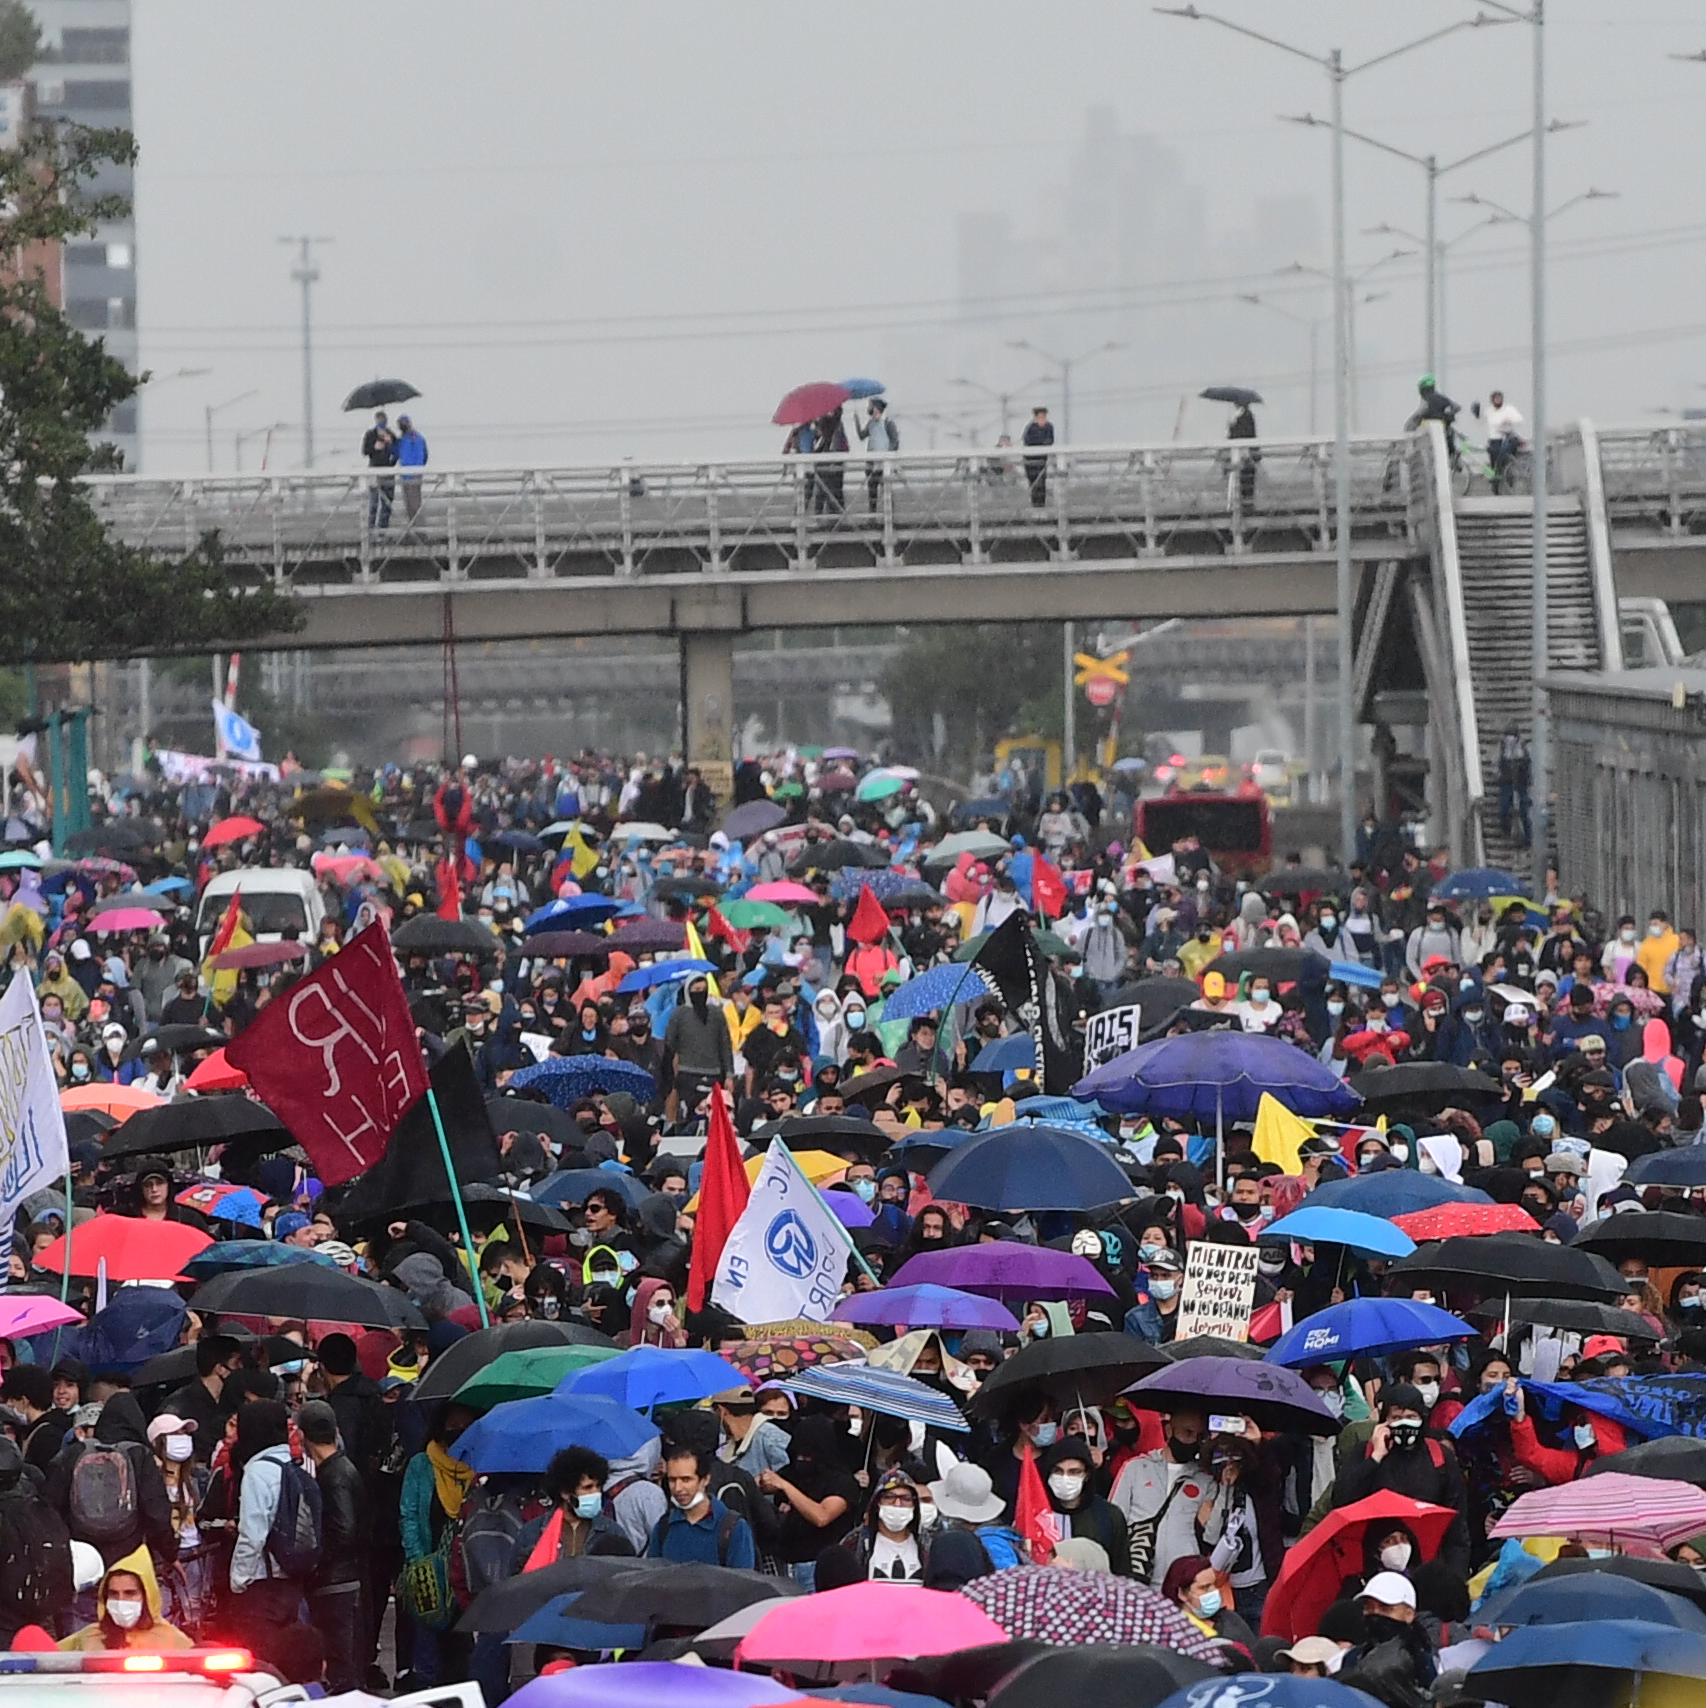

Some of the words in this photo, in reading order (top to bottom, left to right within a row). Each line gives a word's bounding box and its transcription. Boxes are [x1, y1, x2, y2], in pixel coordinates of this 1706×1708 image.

[1191, 1246, 1258, 1271] MIENTRAS
[1188, 1266, 1204, 1279] NO
[1183, 1299, 1196, 1314] NO
